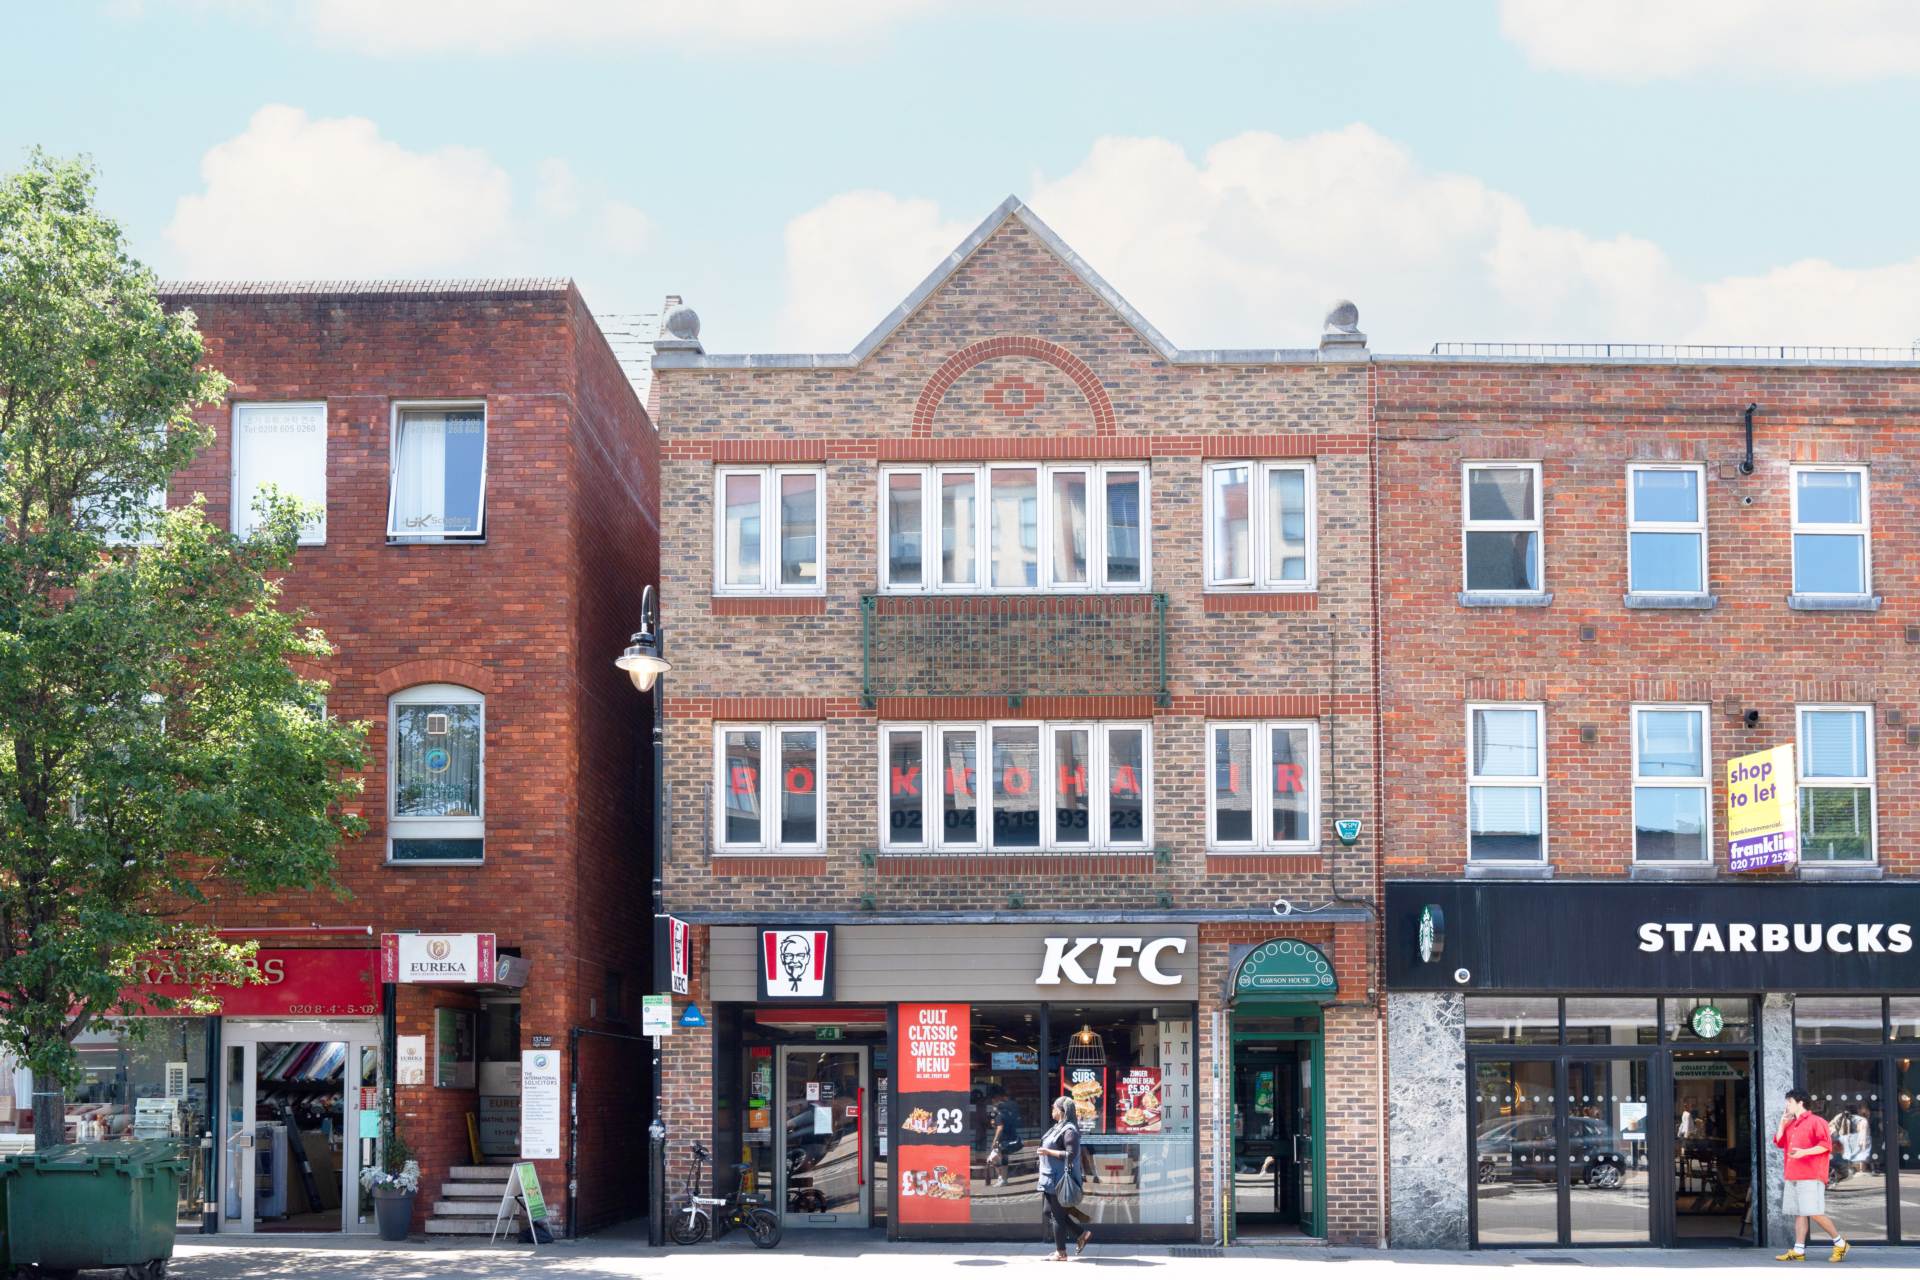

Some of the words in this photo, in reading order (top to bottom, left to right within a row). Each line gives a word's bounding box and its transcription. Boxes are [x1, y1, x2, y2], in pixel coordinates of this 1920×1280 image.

[1730, 762, 1772, 784] shop
[1730, 792, 1748, 808] to
[1754, 783, 1776, 803] let
[1730, 834, 1794, 860] franklin
[1731, 859, 1748, 871] 020
[1749, 855, 1770, 867] 7117
[1638, 922, 1913, 953] STARBUCKS
[411, 962, 467, 972] EUREKA
[1035, 937, 1187, 985] KFC
[673, 975, 686, 993] KFC
[919, 1009, 948, 1025] CULT
[908, 1025, 958, 1040] CLASSIC
[911, 1041, 956, 1057] SAVERS
[916, 1057, 950, 1073] MENU
[1072, 1071, 1096, 1082] SUBS
[1142, 1077, 1155, 1085] DEAL
[1127, 1084, 1150, 1095] £5.99
[936, 1107, 963, 1134] £3
[902, 1170, 928, 1196] £5
